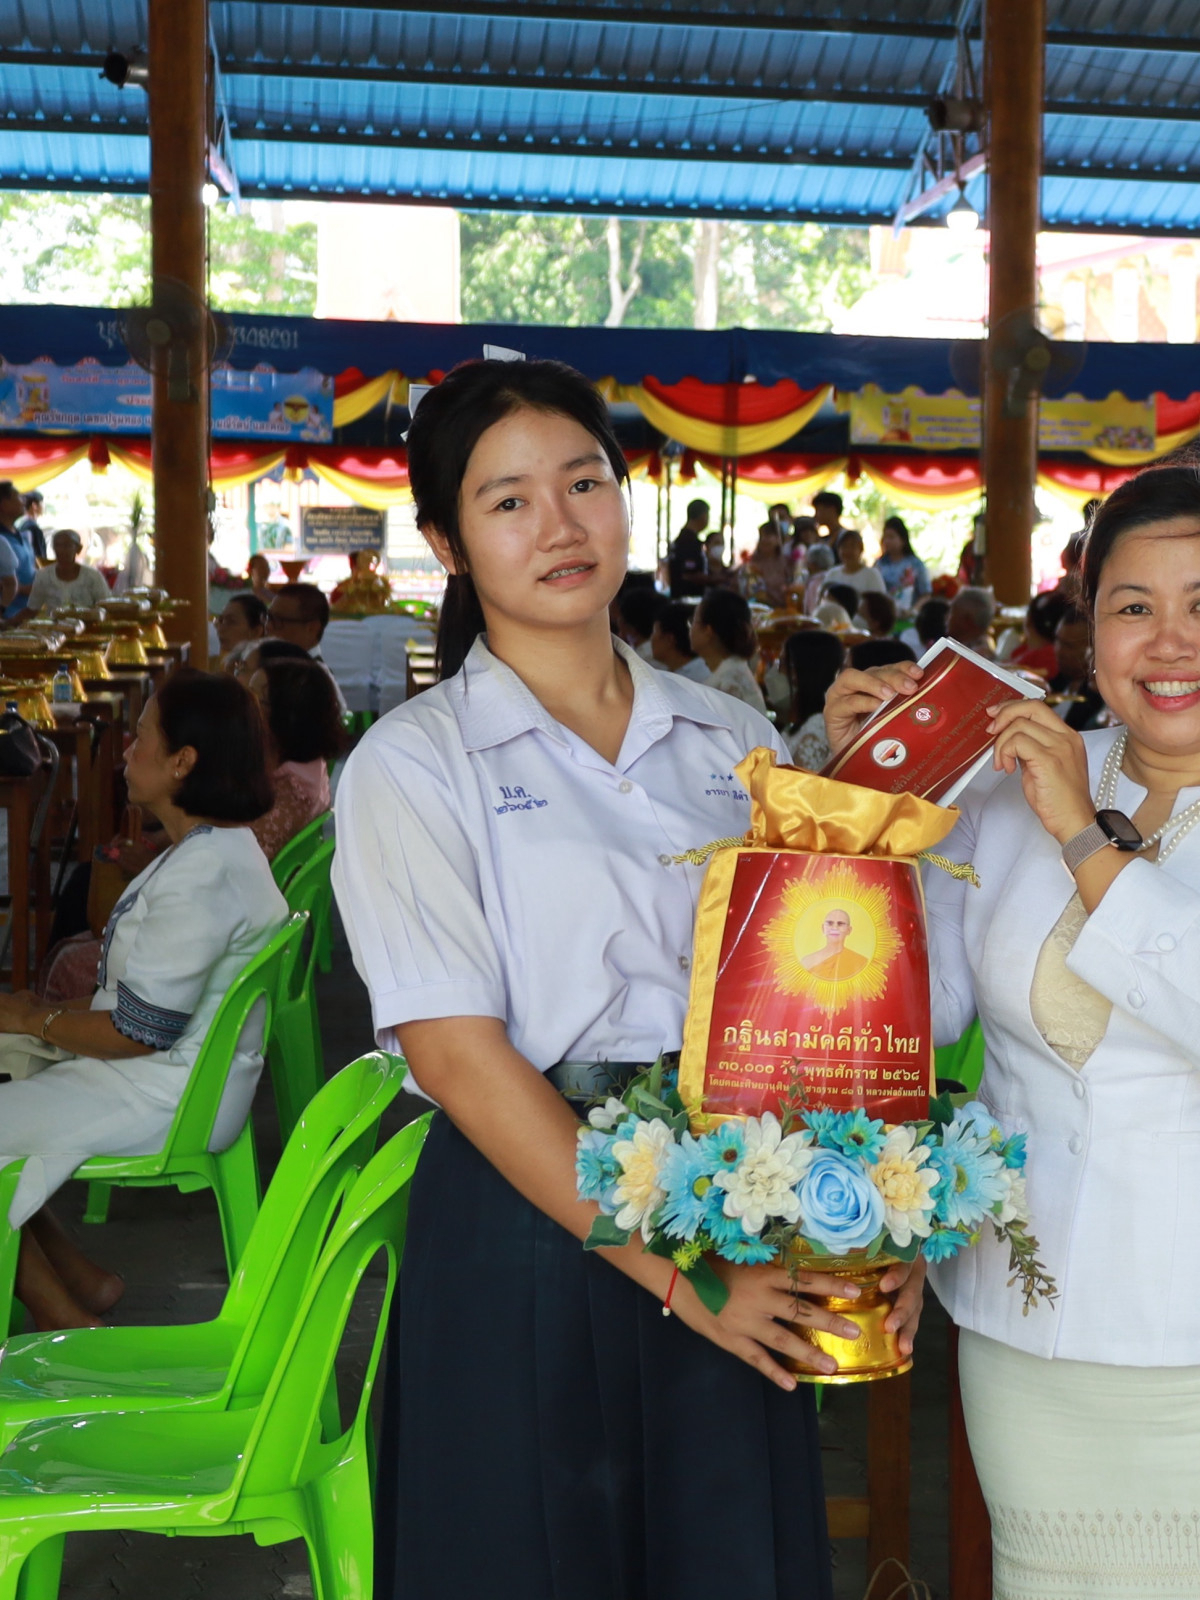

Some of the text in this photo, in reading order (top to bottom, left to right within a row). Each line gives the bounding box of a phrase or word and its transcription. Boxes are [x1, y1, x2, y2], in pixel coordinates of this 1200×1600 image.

[723, 1019, 920, 1053] กฐินสามัคคีทั่วไทย
[718, 1060, 775, 1074] ๓๐,๐๐๐
[803, 1063, 878, 1082] พุทธศักราช
[882, 1068, 920, 1081] ๒๕๖๘
